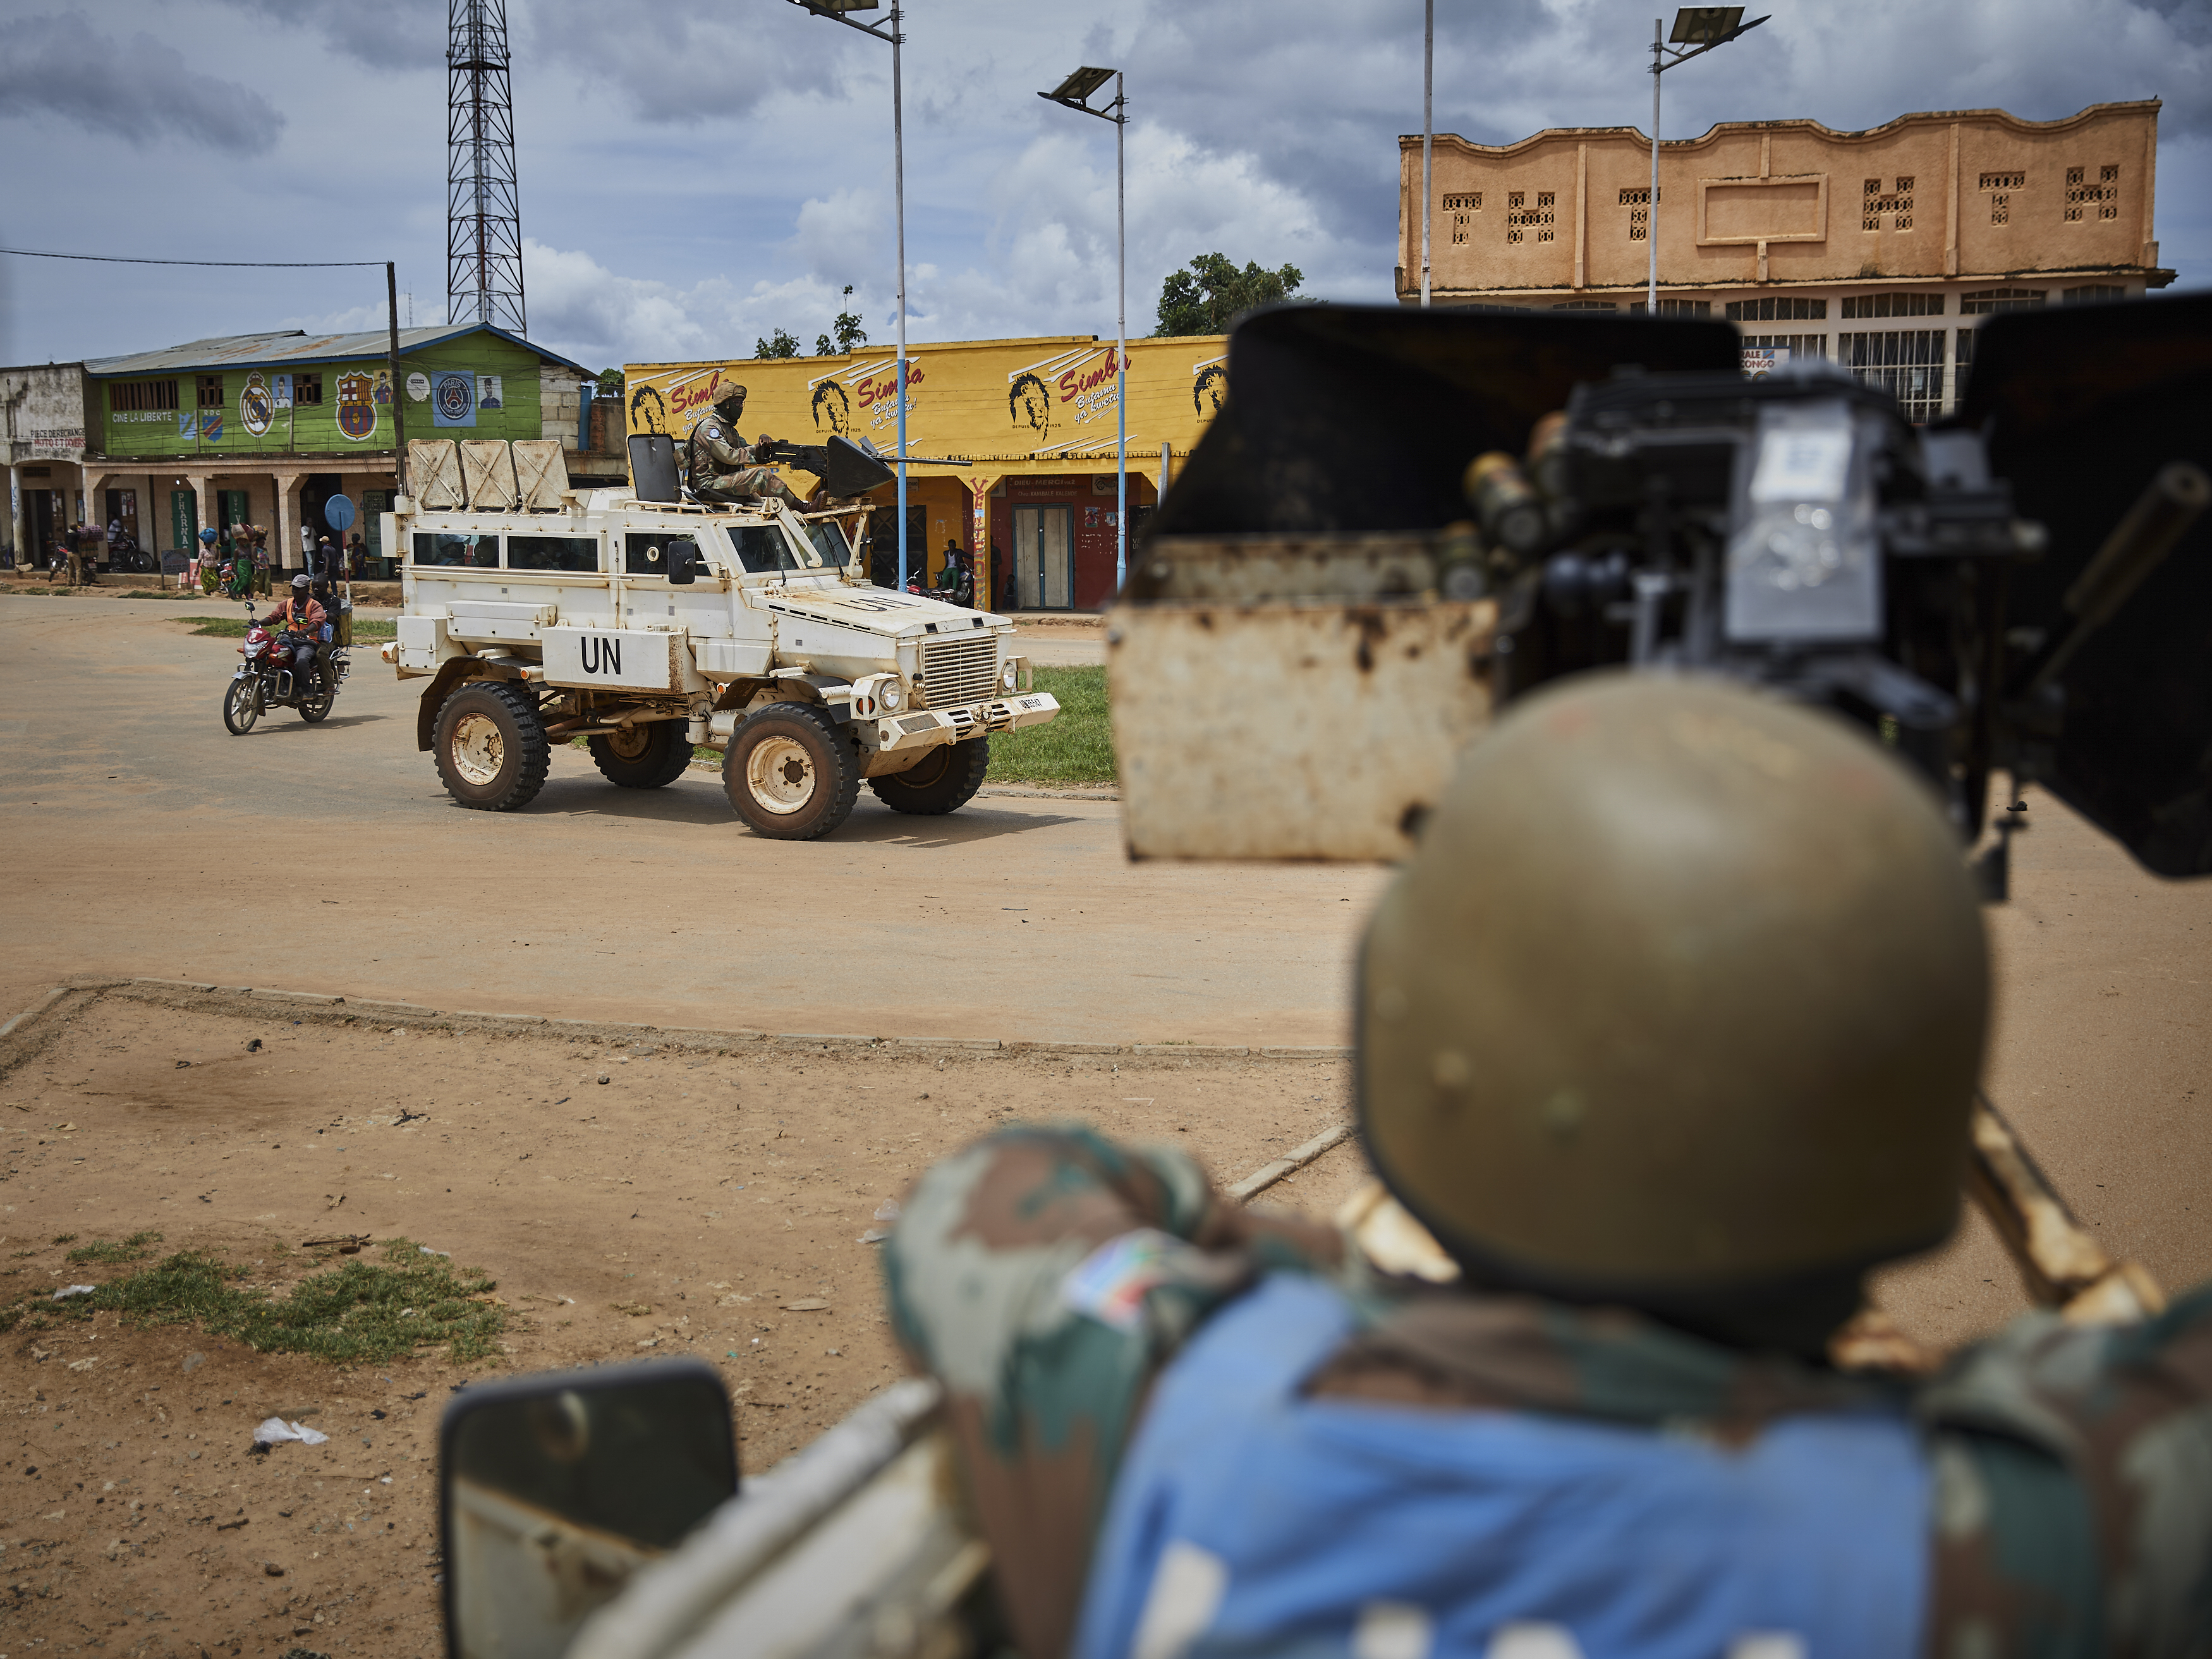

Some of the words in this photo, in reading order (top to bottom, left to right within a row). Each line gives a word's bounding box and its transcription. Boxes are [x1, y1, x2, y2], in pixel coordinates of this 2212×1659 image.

[443, 380, 461, 389] PARIS
[671, 372, 729, 413] Simb
[1075, 384, 1117, 409] Butamu
[130, 413, 139, 423] LA
[140, 411, 172, 422] LIBERTE
[870, 416, 884, 430] ya
[1074, 410, 1089, 424] ya
[30, 430, 47, 438] PIECE
[34, 439, 54, 447] MOTO
[581, 636, 621, 675] UN
